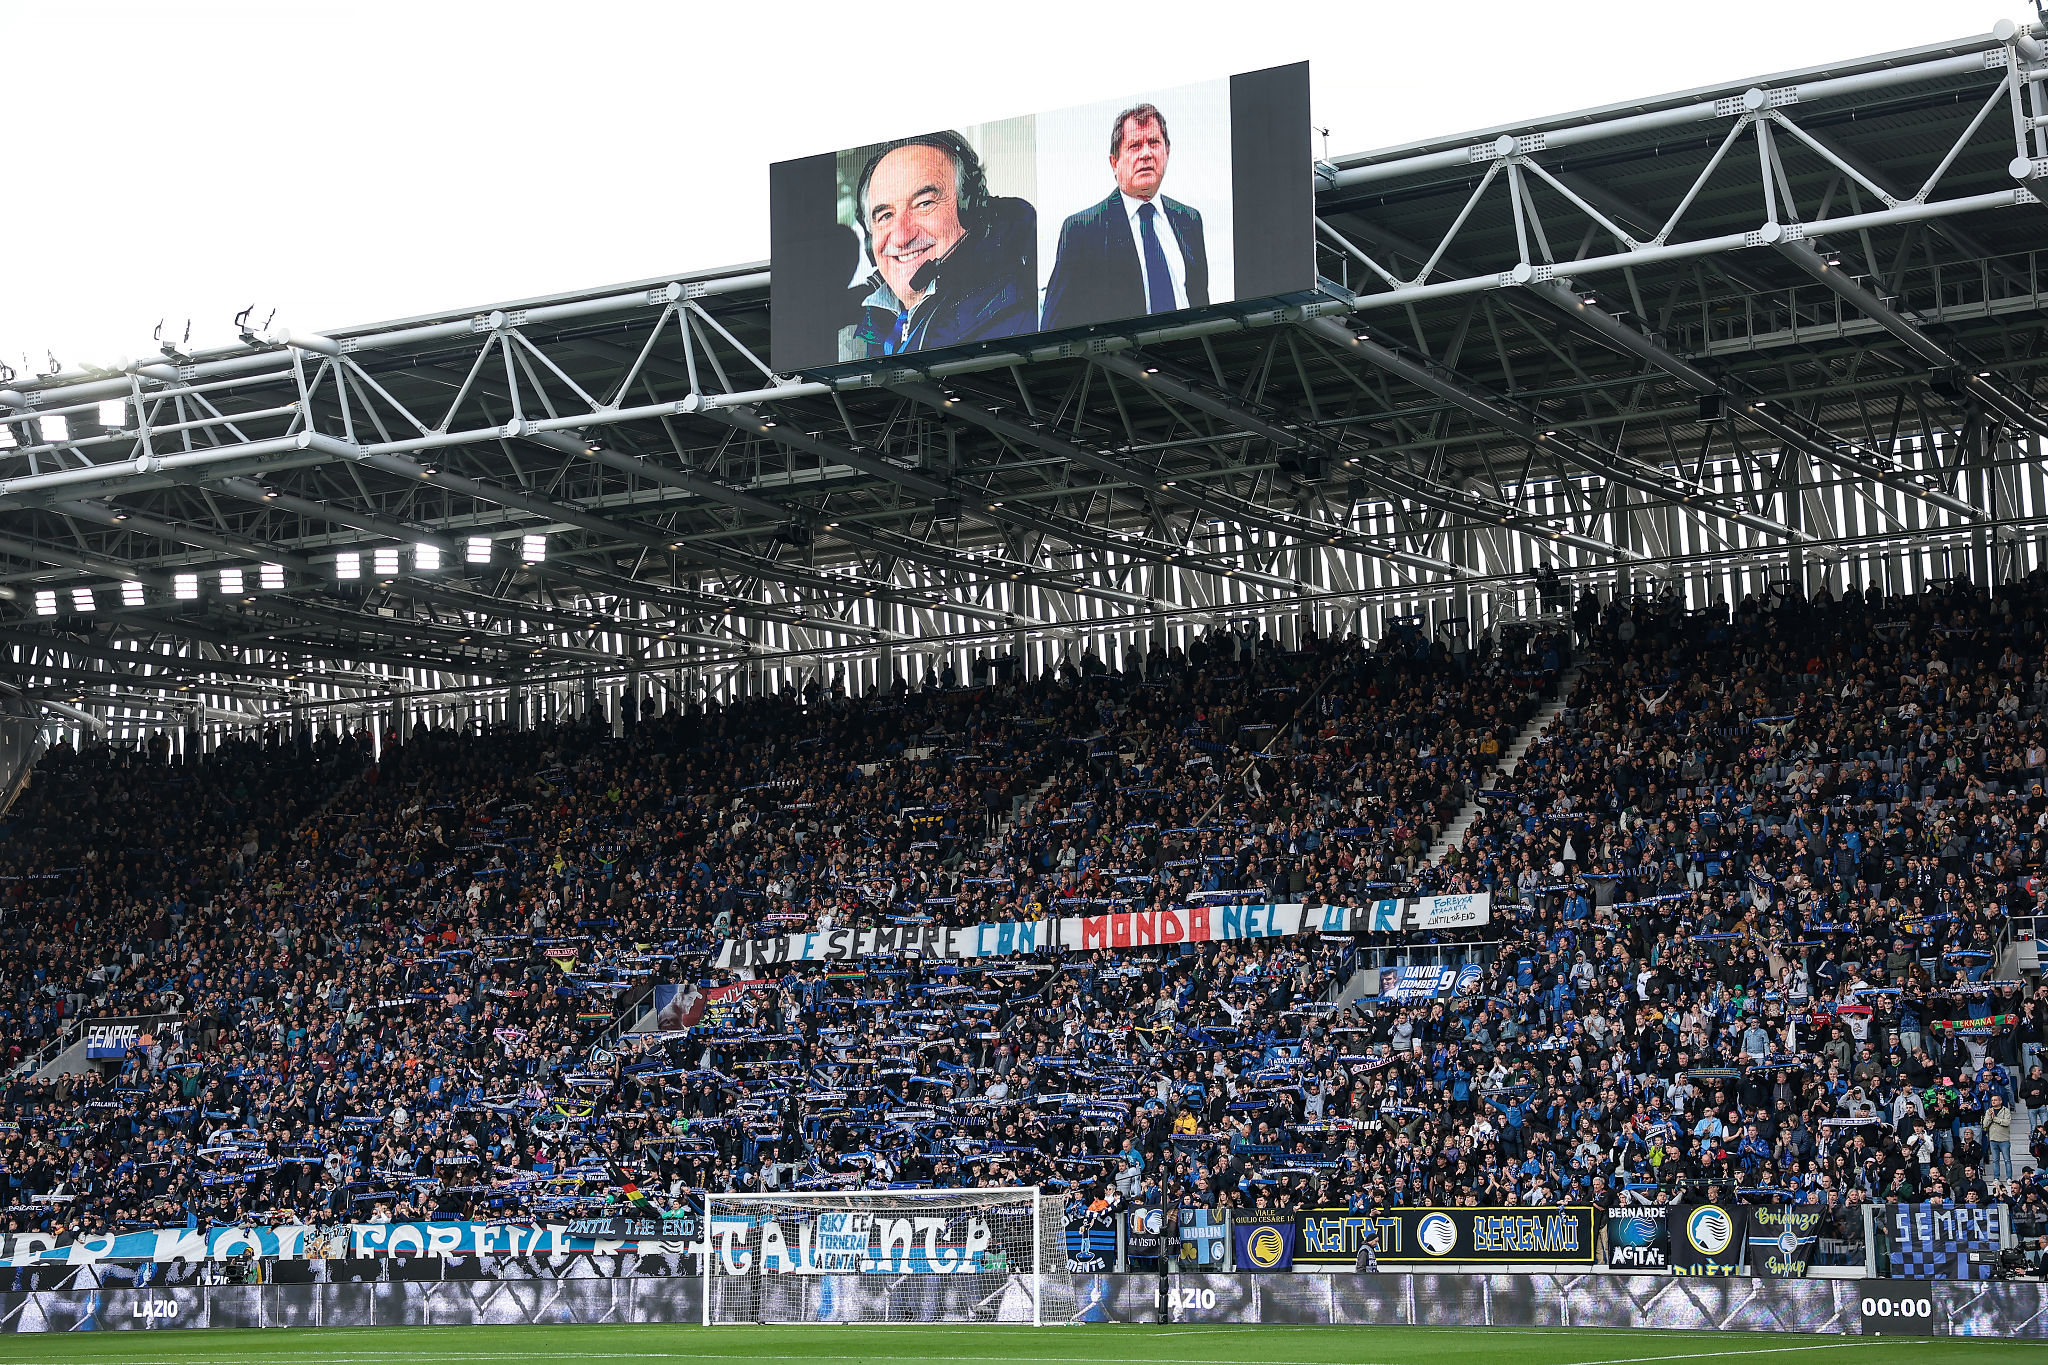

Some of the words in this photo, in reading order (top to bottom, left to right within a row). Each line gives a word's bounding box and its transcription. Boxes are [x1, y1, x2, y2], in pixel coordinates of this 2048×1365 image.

[729, 936, 790, 967] ORA
[825, 927, 962, 960] SEMPRE
[977, 921, 1036, 956] CON
[1047, 916, 1070, 950] IL
[1082, 907, 1210, 950] MONDO
[1222, 904, 1282, 938] NEL
[1298, 898, 1421, 932] CUORE
[1404, 966, 1442, 978] DAVIDE
[1400, 980, 1438, 988] BOMBER
[1438, 971, 1456, 991] 9
[1397, 989, 1408, 997] PER
[1409, 989, 1434, 997] SEMPRE
[1956, 1018, 1992, 1027] TERNANA
[88, 1025, 139, 1048] SEMPRE
[1084, 1110, 1116, 1118] ATALANTA
[1236, 1215, 1257, 1223] GIULIO
[1258, 1215, 1284, 1223] CESARE
[1608, 1207, 1665, 1218] BERNARDE
[1756, 1207, 1820, 1231] Brianza
[568, 1219, 615, 1234] UNTIL
[625, 1219, 656, 1235] THE
[663, 1219, 694, 1236] END
[1184, 1227, 1222, 1239] DUBLIN
[1303, 1216, 1402, 1252] AGITATI
[1473, 1215, 1580, 1252] BERGAMO
[1895, 1209, 1999, 1242] SEMPRE
[1139, 1237, 1157, 1246] VISTO
[1612, 1246, 1664, 1265] AGITATE
[133, 1300, 178, 1317] LAZIO
[1861, 1298, 1932, 1318] 00:00
